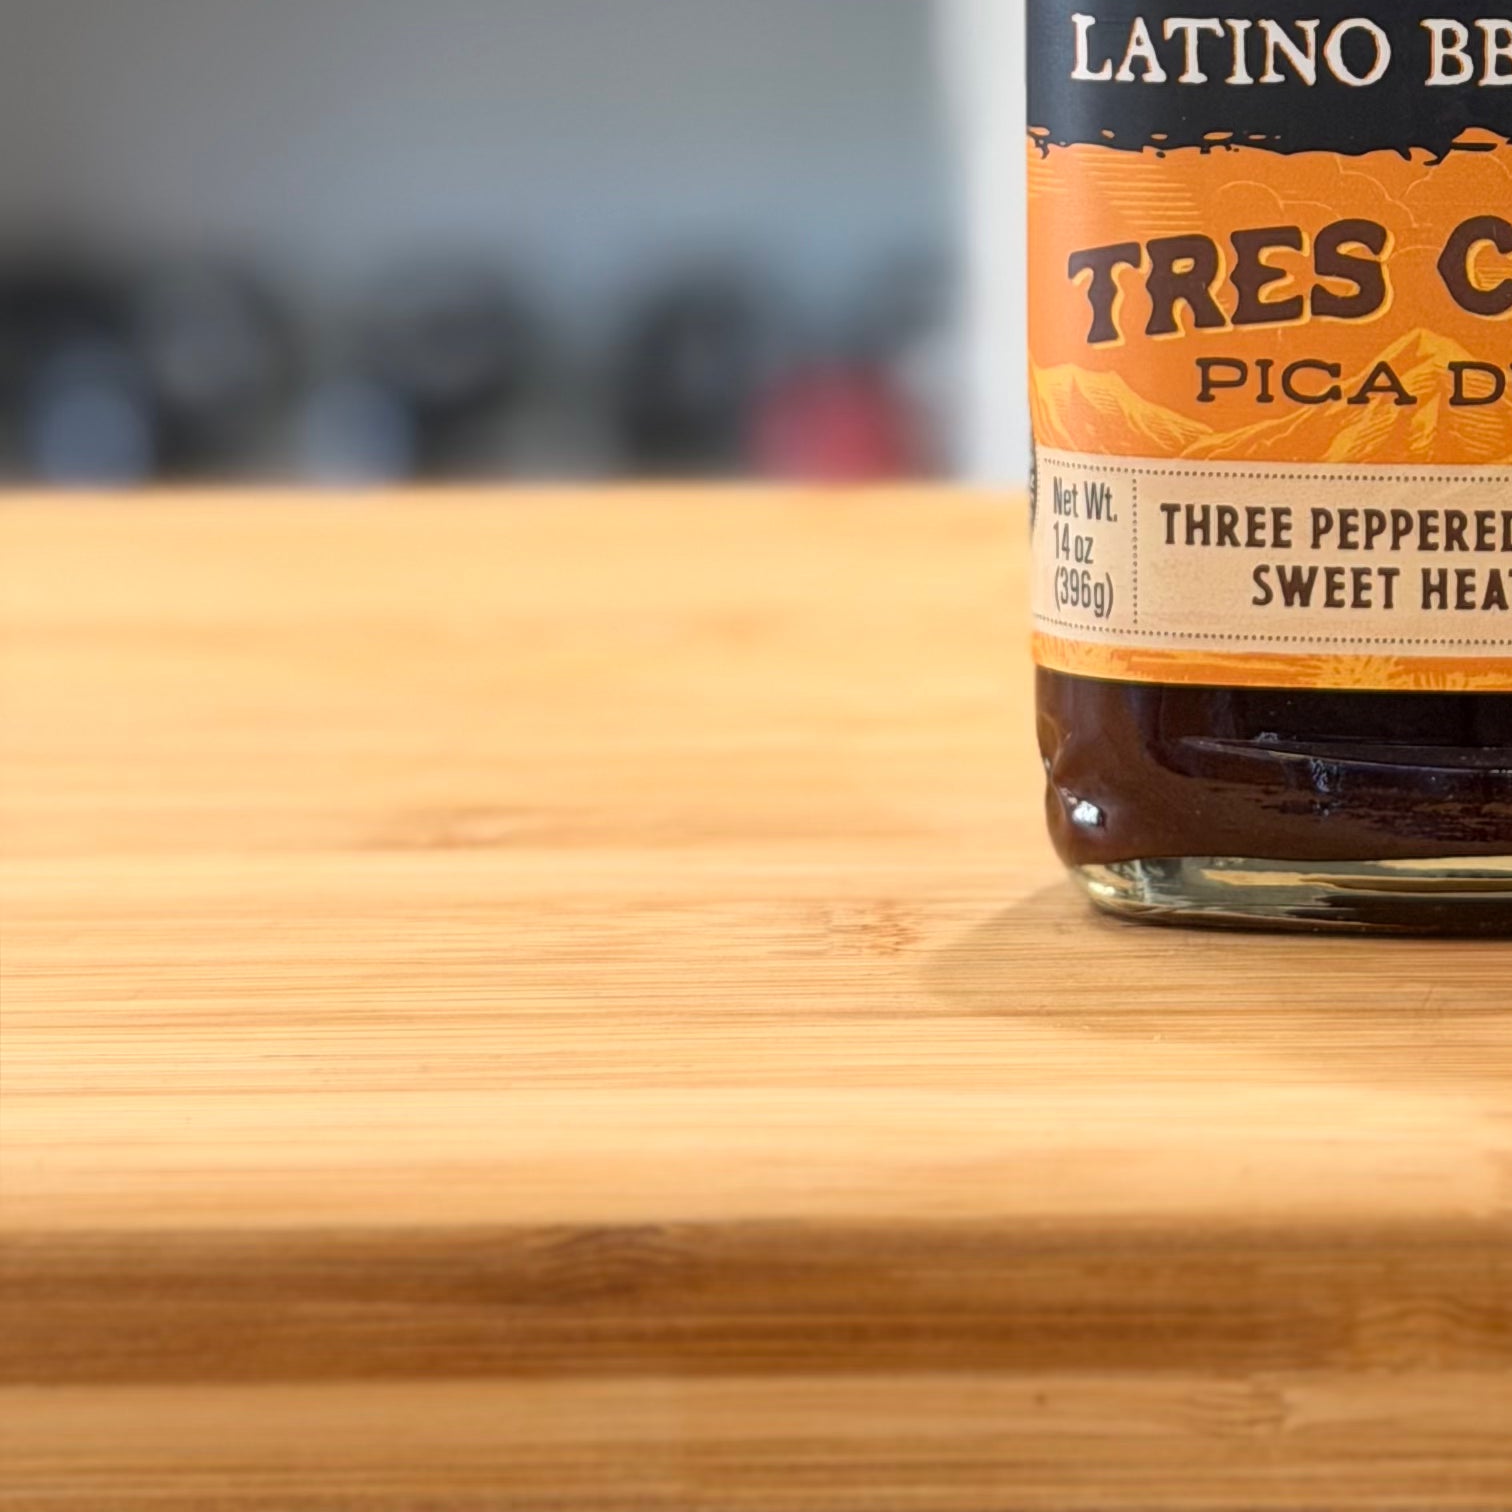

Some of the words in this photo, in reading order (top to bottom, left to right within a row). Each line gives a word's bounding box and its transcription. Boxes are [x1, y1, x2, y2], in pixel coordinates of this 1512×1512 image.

[1070, 14, 1392, 87] LATINO
[1068, 219, 1390, 344] TRES
[1195, 357, 1416, 405] PICA
[1052, 475, 1079, 516] Net
[1083, 481, 1118, 522] Wt.
[1052, 520, 1071, 559] 14
[1074, 535, 1094, 564] oz
[1160, 503, 1293, 549] THREE
[1053, 566, 1115, 618] (396g)
[1252, 564, 1400, 608] SWEET
